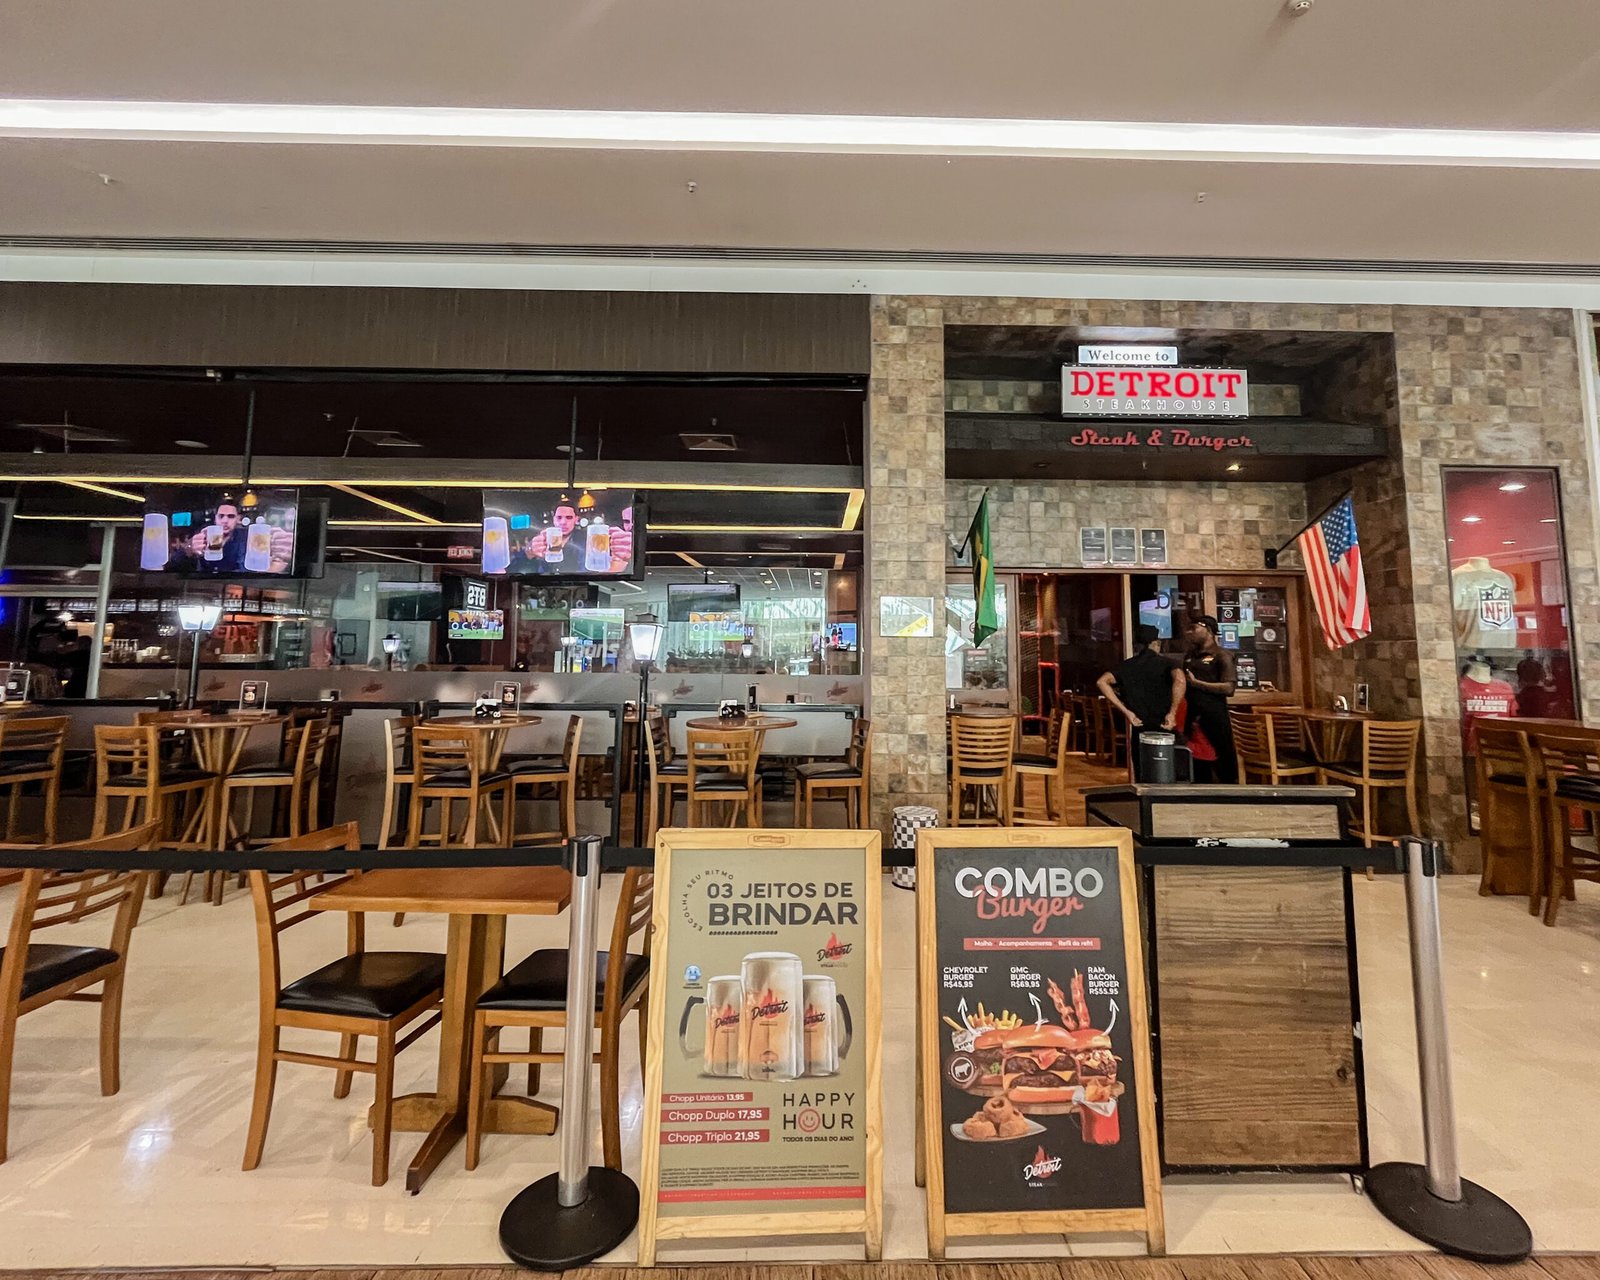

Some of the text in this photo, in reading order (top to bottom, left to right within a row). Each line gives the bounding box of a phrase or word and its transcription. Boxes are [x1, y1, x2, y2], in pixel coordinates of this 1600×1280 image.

[1088, 349, 1169, 362] Welcome to
[1070, 371, 1242, 398] DETROIT
[1082, 399, 1231, 411] STEAKHOUSE
[1070, 428, 1254, 450] Steak & Burger
[955, 867, 1104, 898] COMBO
[707, 882, 853, 899] 03 JEITOS DE
[682, 869, 734, 932] ESCOLHA SEU RITMO
[708, 902, 859, 926] BRINDAR
[972, 884, 1084, 934] Burger
[816, 943, 853, 962] Detroit
[943, 966, 989, 974] CHEVROLET
[1010, 966, 1029, 974] GMC
[1087, 966, 1106, 974] RAM
[943, 973, 975, 981] BURGER
[1010, 973, 1042, 981] BURGER
[1088, 973, 1116, 981] BACON
[1088, 980, 1120, 988] BURGER
[751, 1000, 789, 1021] Detroit
[669, 1095, 695, 1103] Chopp
[696, 1094, 725, 1102] Unitário
[783, 1092, 856, 1107] HAPPY
[668, 1109, 763, 1122] Chopp Duplo 17,95
[667, 1131, 761, 1144] Chopp Triplo 21,95
[1022, 1156, 1062, 1180] Detroit
